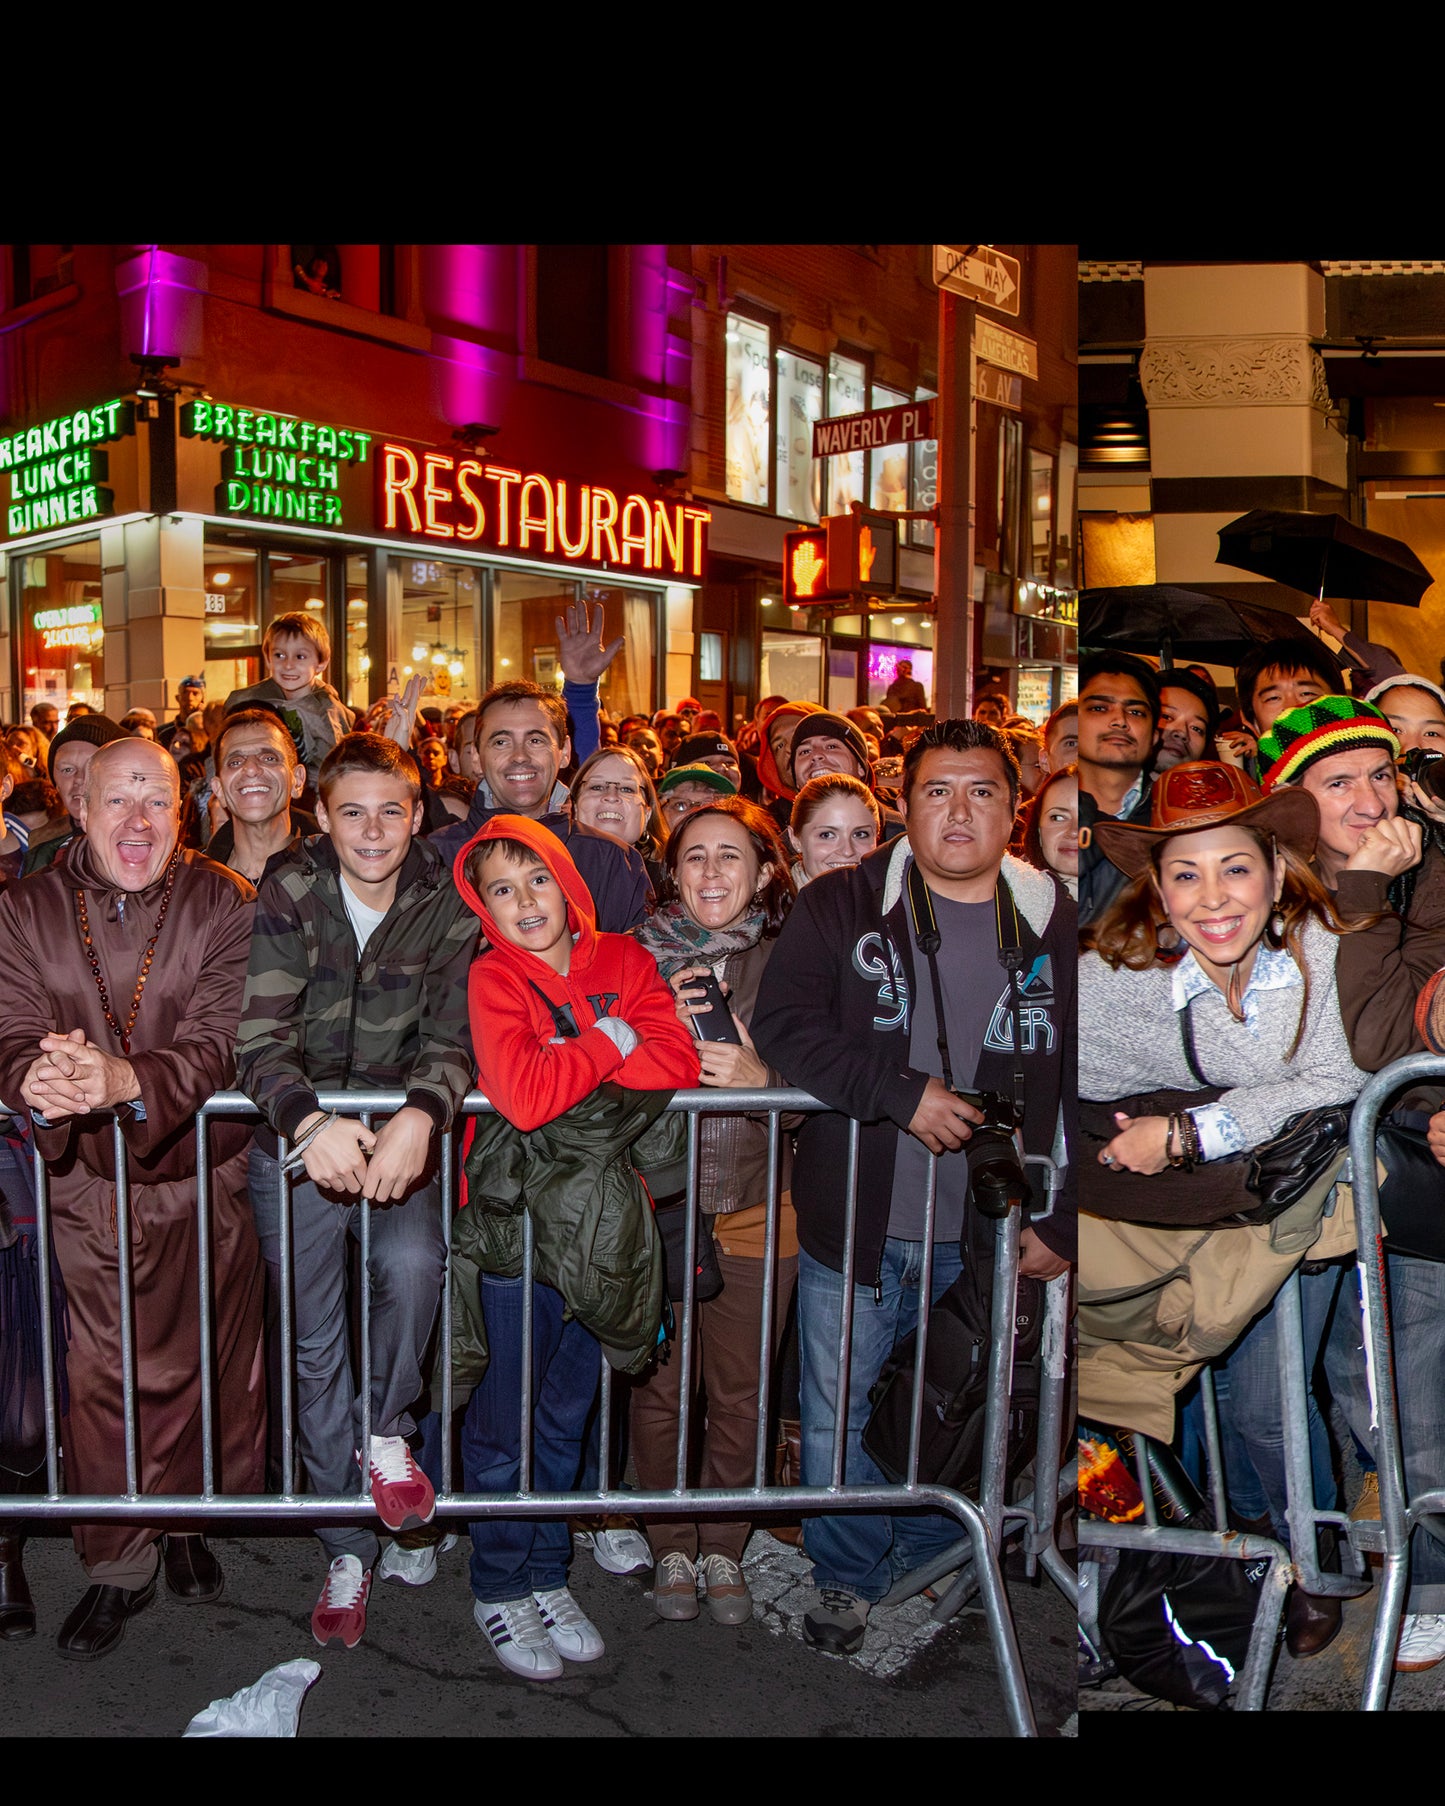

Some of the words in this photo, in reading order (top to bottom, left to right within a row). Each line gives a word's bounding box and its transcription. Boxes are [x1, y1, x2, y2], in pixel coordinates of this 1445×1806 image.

[946, 252, 970, 279] ONE
[984, 265, 1007, 293] WAY
[794, 361, 823, 389] Lase
[981, 336, 1030, 374] AMERICAS
[979, 369, 988, 396] 6
[996, 372, 1013, 403] AV
[193, 400, 372, 463] BREAKFAST
[816, 414, 892, 455] WAVERLY
[902, 410, 925, 441] PL
[11, 448, 91, 500] LUNCH
[235, 444, 338, 490] LUNCH
[8, 484, 98, 535] DINNER
[228, 479, 343, 526] DINNER
[384, 443, 712, 575] RESTAURANT
[205, 595, 224, 611] 85
[388, 666, 400, 685] A
